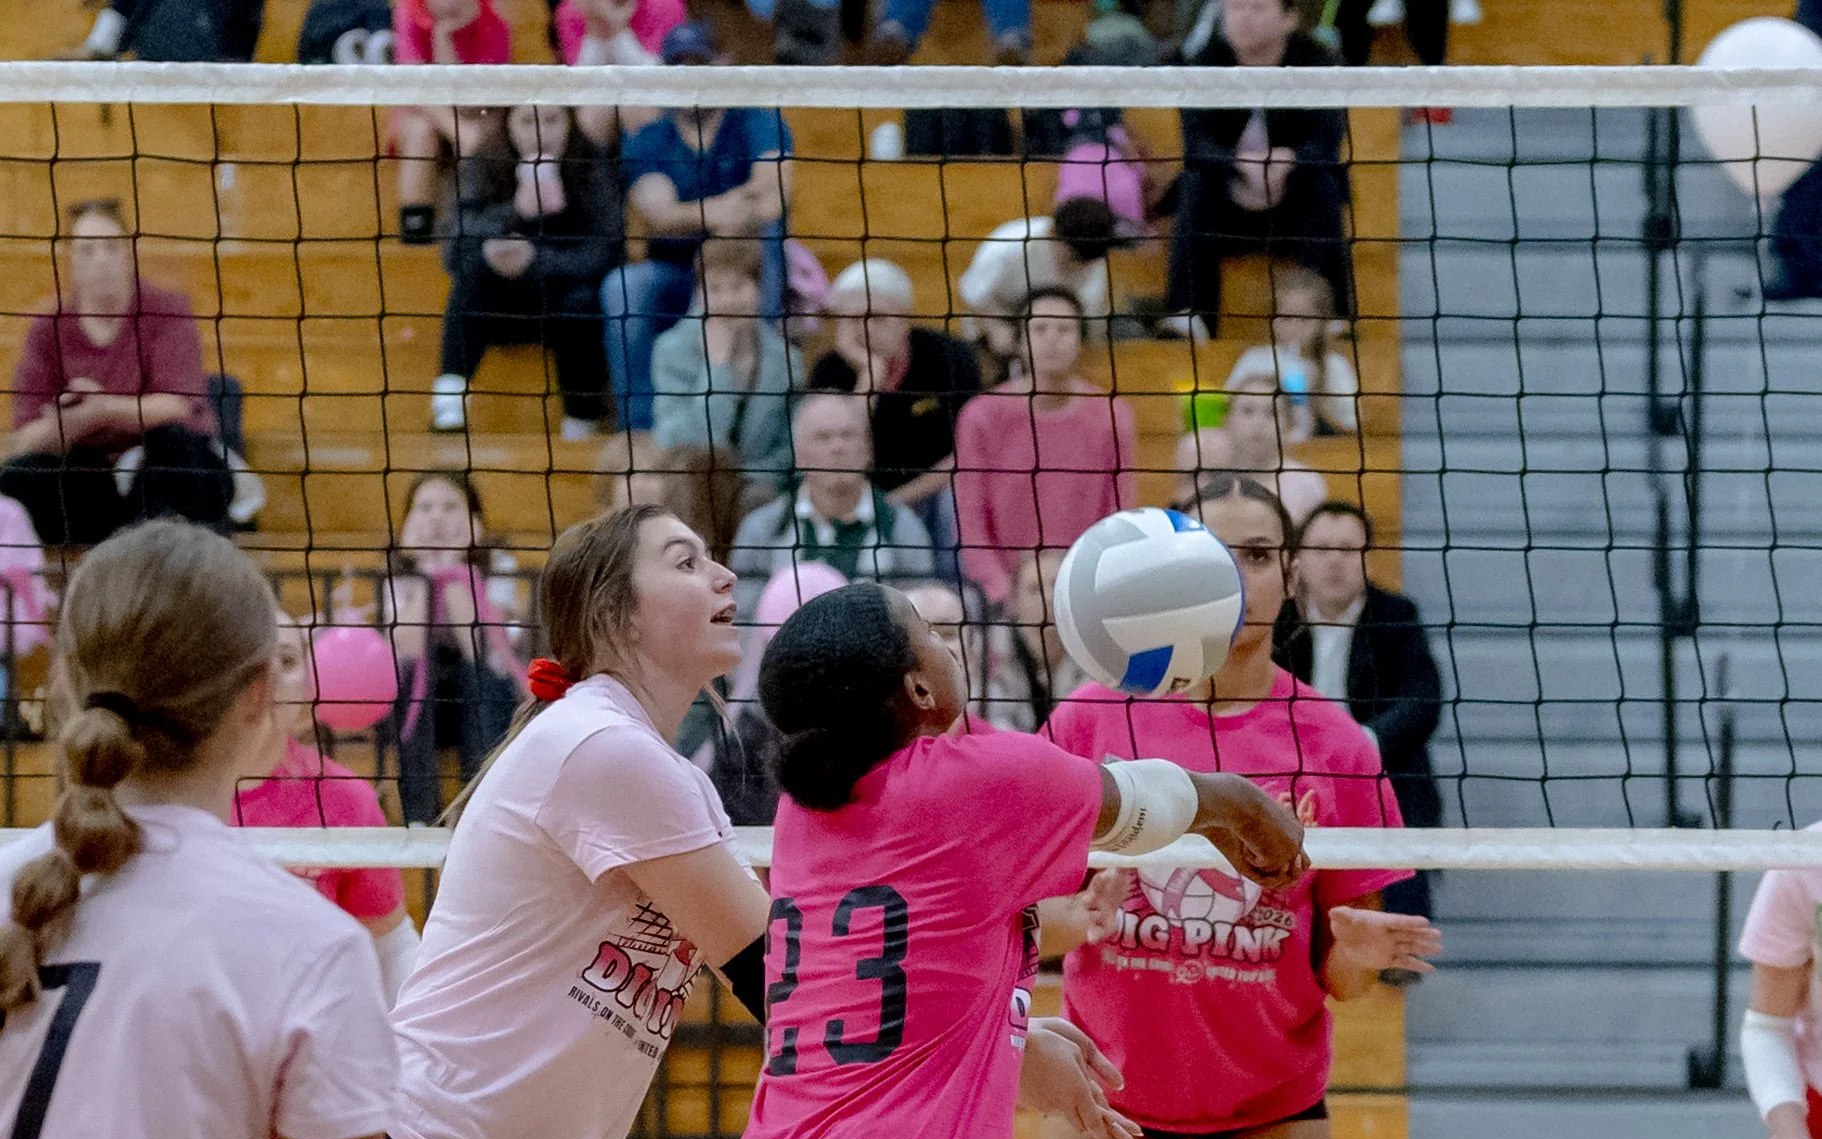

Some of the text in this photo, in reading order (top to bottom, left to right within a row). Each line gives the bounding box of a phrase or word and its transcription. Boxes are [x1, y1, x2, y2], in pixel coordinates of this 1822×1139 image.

[1180, 917, 1291, 964] PINK
[766, 885, 908, 1076] 23
[567, 986, 601, 1012] RIVALS
[600, 1007, 614, 1021] ON
[611, 1014, 626, 1031] THE
